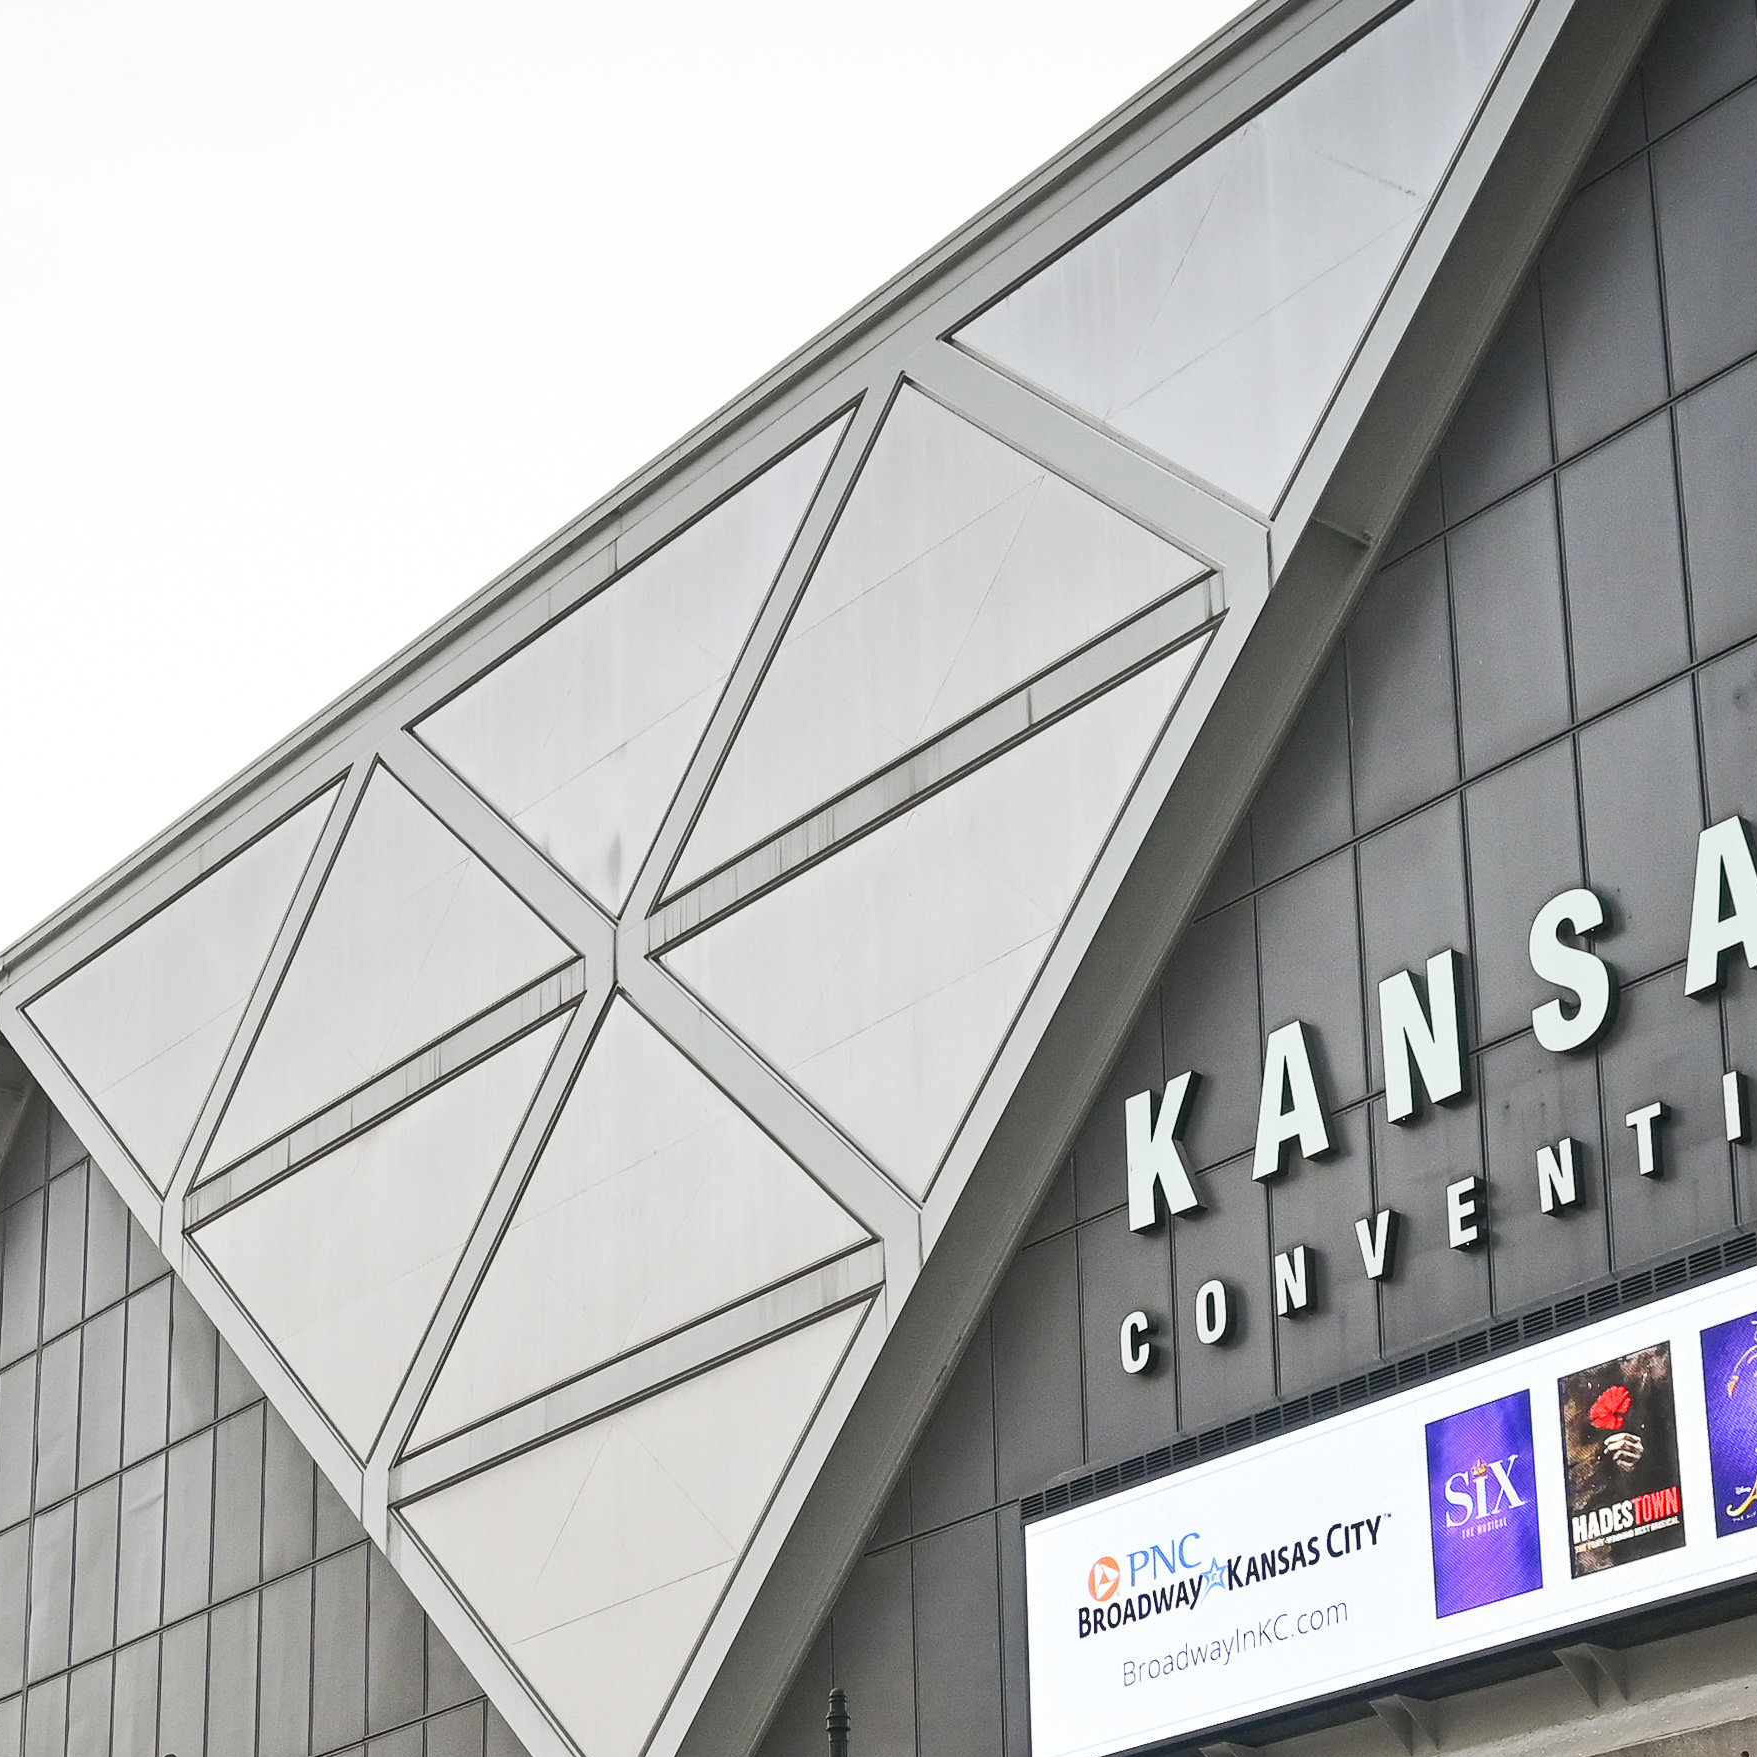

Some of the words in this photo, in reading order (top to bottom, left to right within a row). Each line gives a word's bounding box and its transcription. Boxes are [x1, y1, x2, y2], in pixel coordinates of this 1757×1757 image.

[1444, 1454, 1529, 1529] SIX
[1571, 1486, 1681, 1546] HADESTOWN
[1078, 1573, 1204, 1639] BROADWAY
[1227, 1536, 1321, 1592] KANSAS
[1126, 1532, 1203, 1588] PNC
[1122, 1601, 1349, 1687] BroadwayInKC.com
